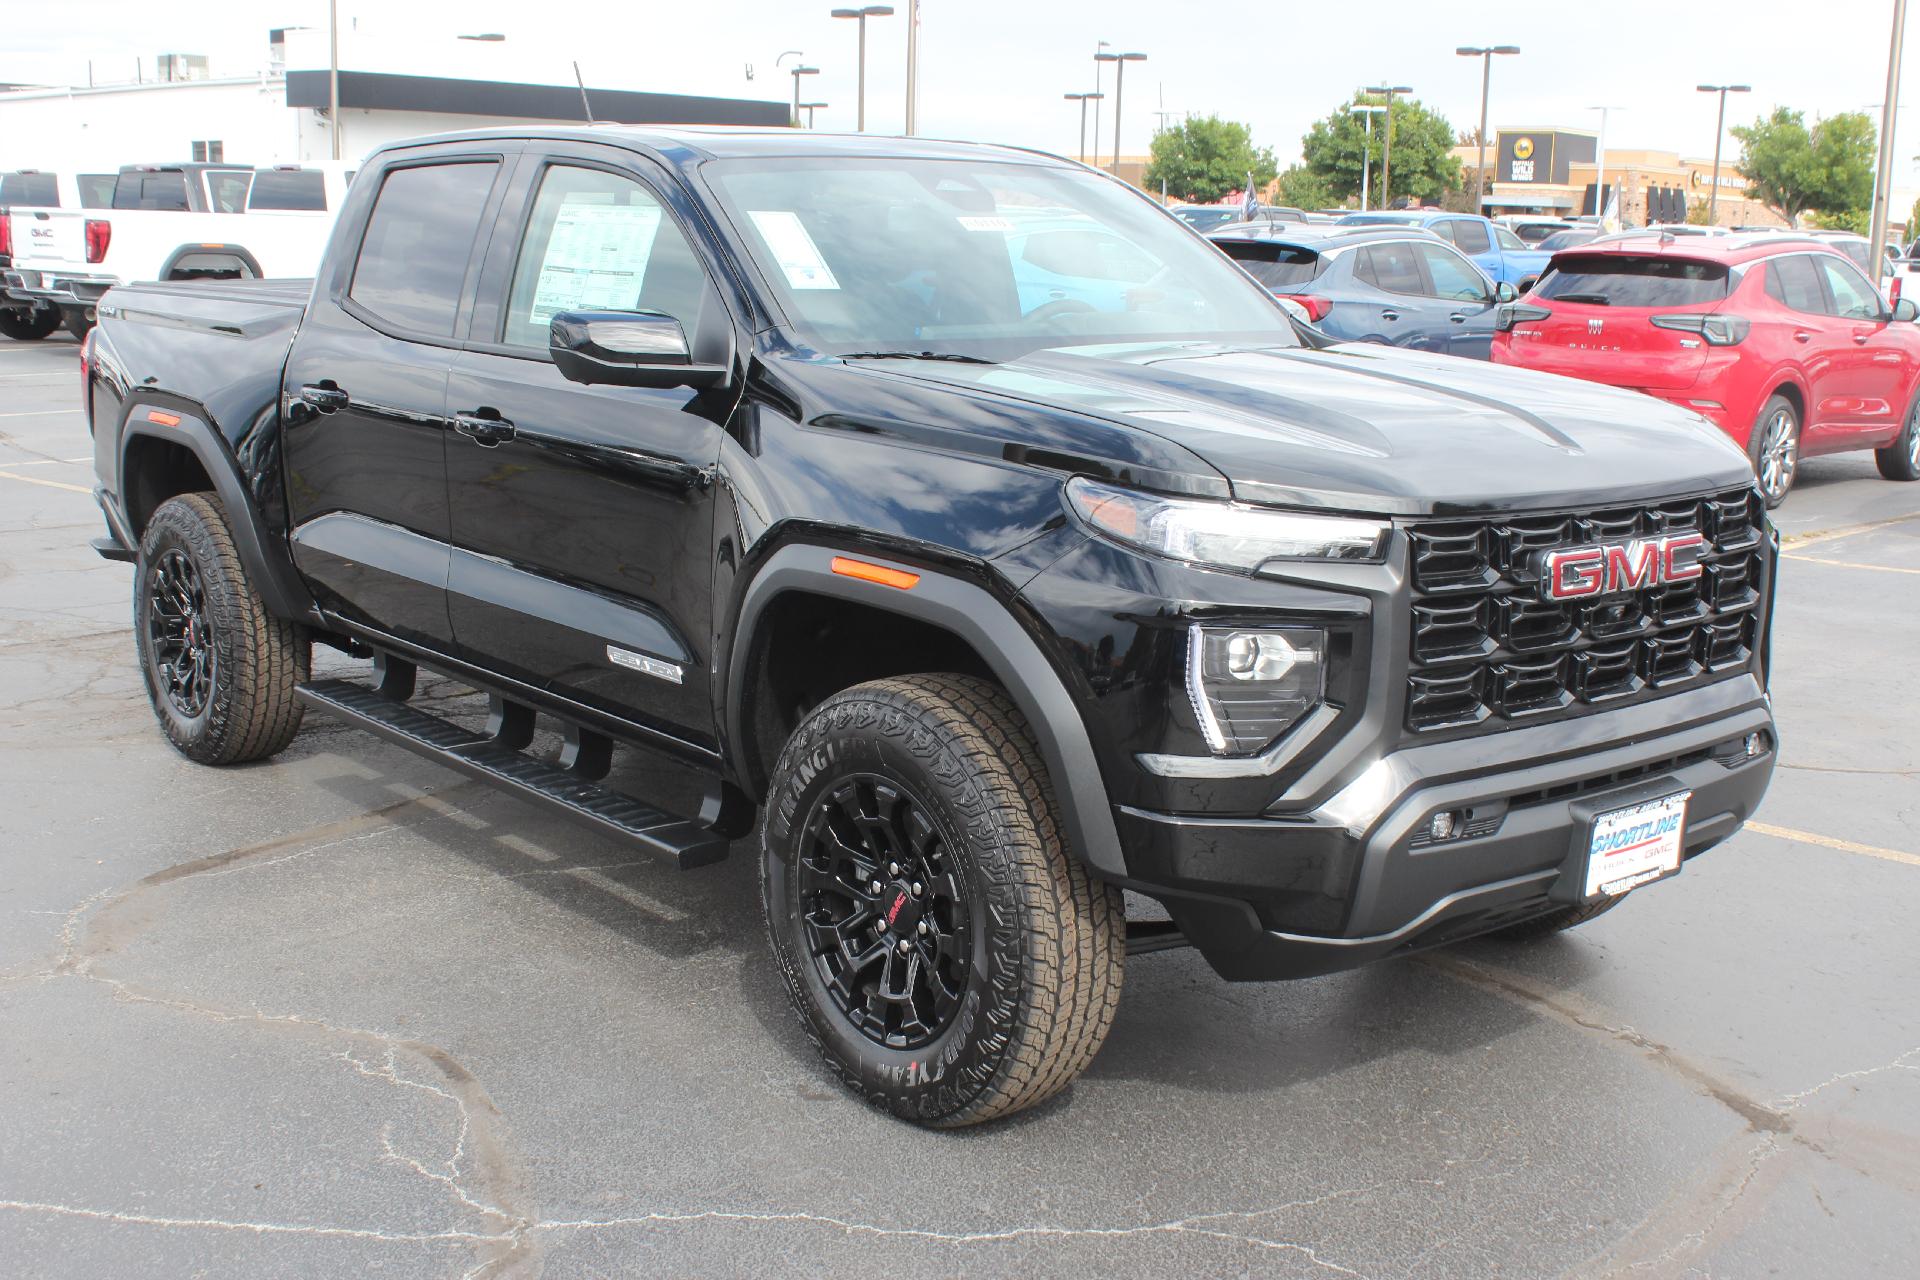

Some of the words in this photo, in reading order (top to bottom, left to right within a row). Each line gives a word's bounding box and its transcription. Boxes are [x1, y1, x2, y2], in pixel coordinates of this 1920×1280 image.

[1512, 165, 1533, 174] WILD
[31, 228, 53, 238] GMC
[1569, 343, 1621, 352] BUICK
[1547, 533, 1703, 601] GMC
[610, 650, 678, 678] ELEVATION
[1591, 813, 1681, 854] SHORTLINE
[1644, 841, 1674, 859] GMC
[889, 890, 906, 925] GMC
